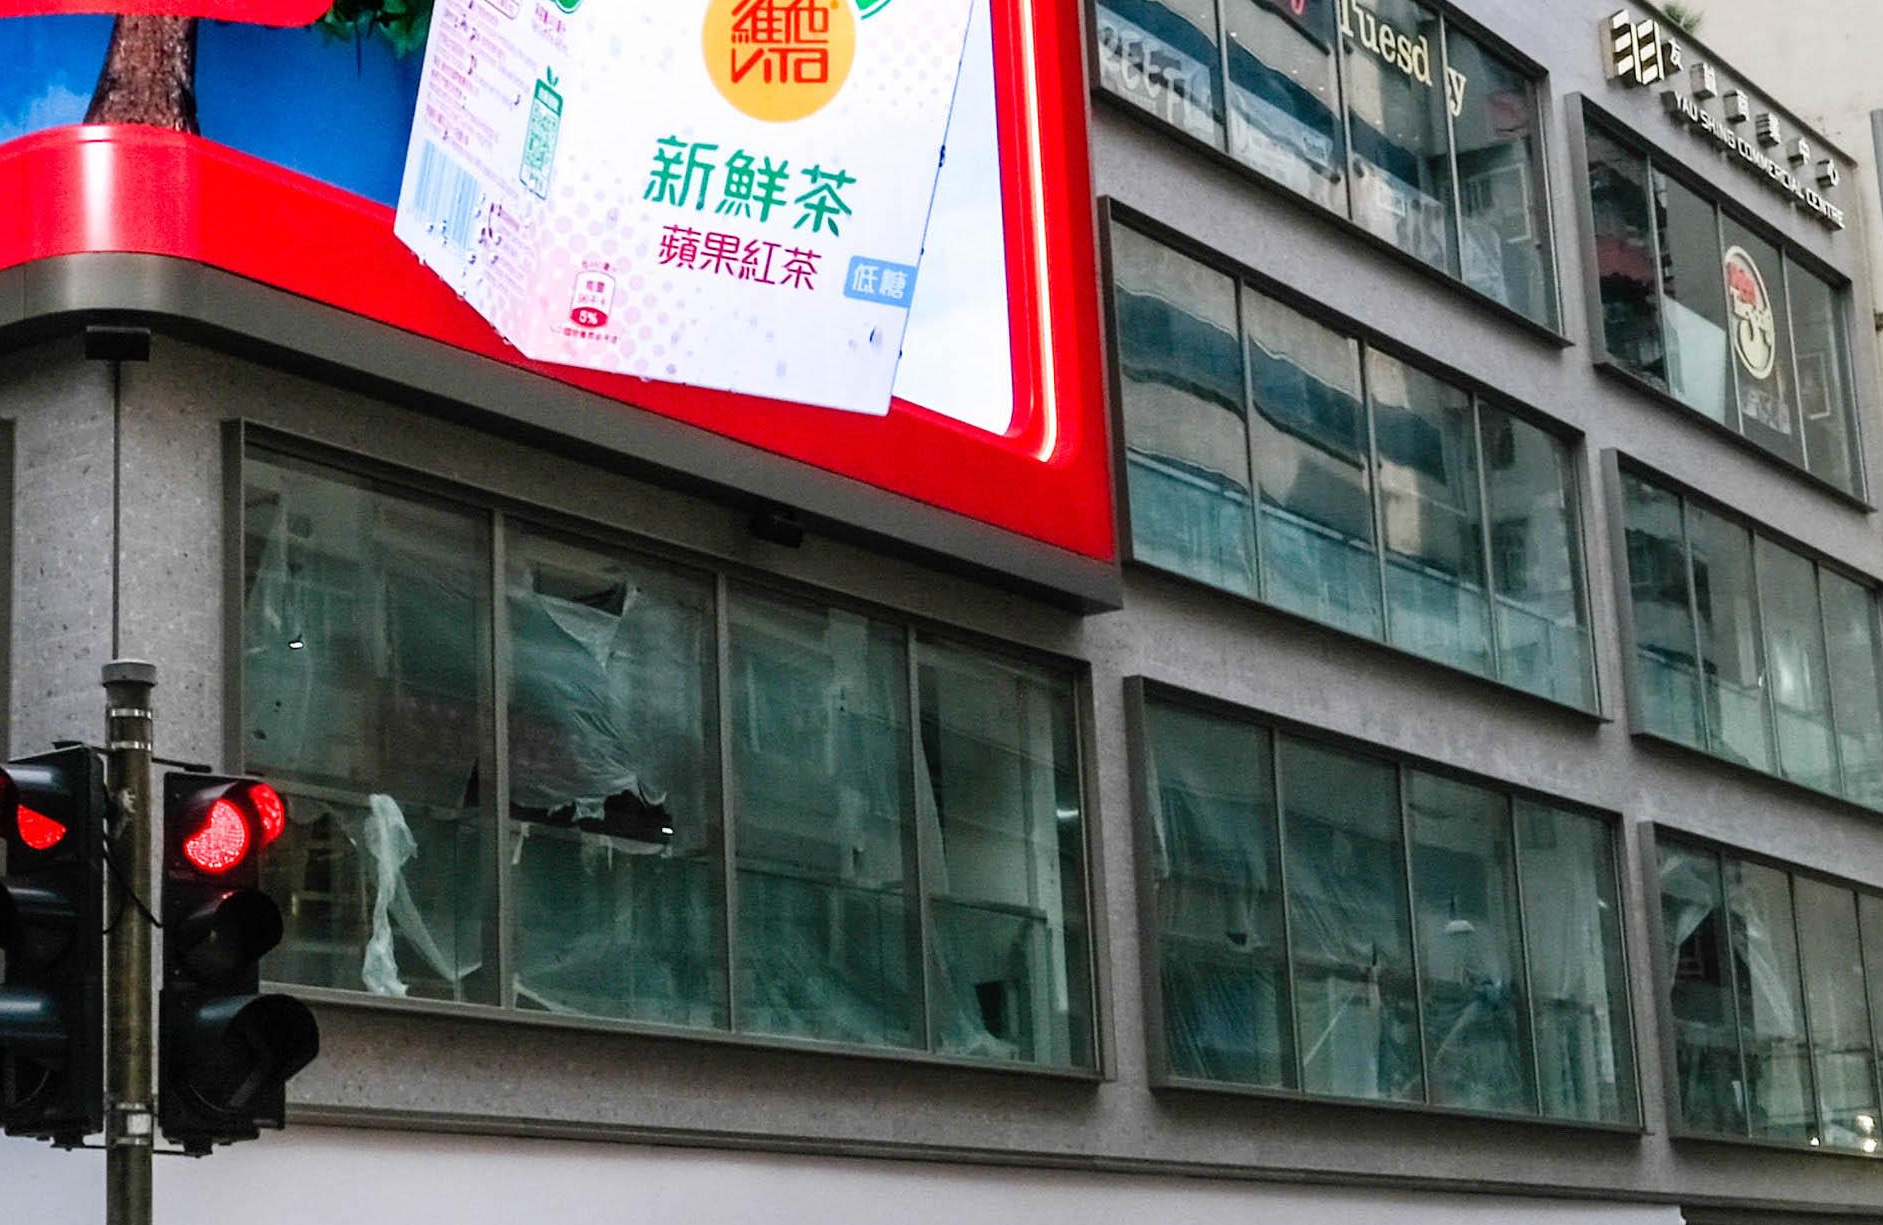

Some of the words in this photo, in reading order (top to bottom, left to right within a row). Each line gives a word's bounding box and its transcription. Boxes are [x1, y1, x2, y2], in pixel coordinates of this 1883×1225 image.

[643, 135, 857, 237] 新鮮茶
[1674, 90, 1699, 122] YAU
[1699, 109, 1737, 149] SHING
[1738, 137, 1805, 200] COMMERCIAL
[1805, 187, 1846, 229] CENTRE
[658, 224, 822, 291] 蘋果紅茶
[850, 262, 910, 301] 低糖
